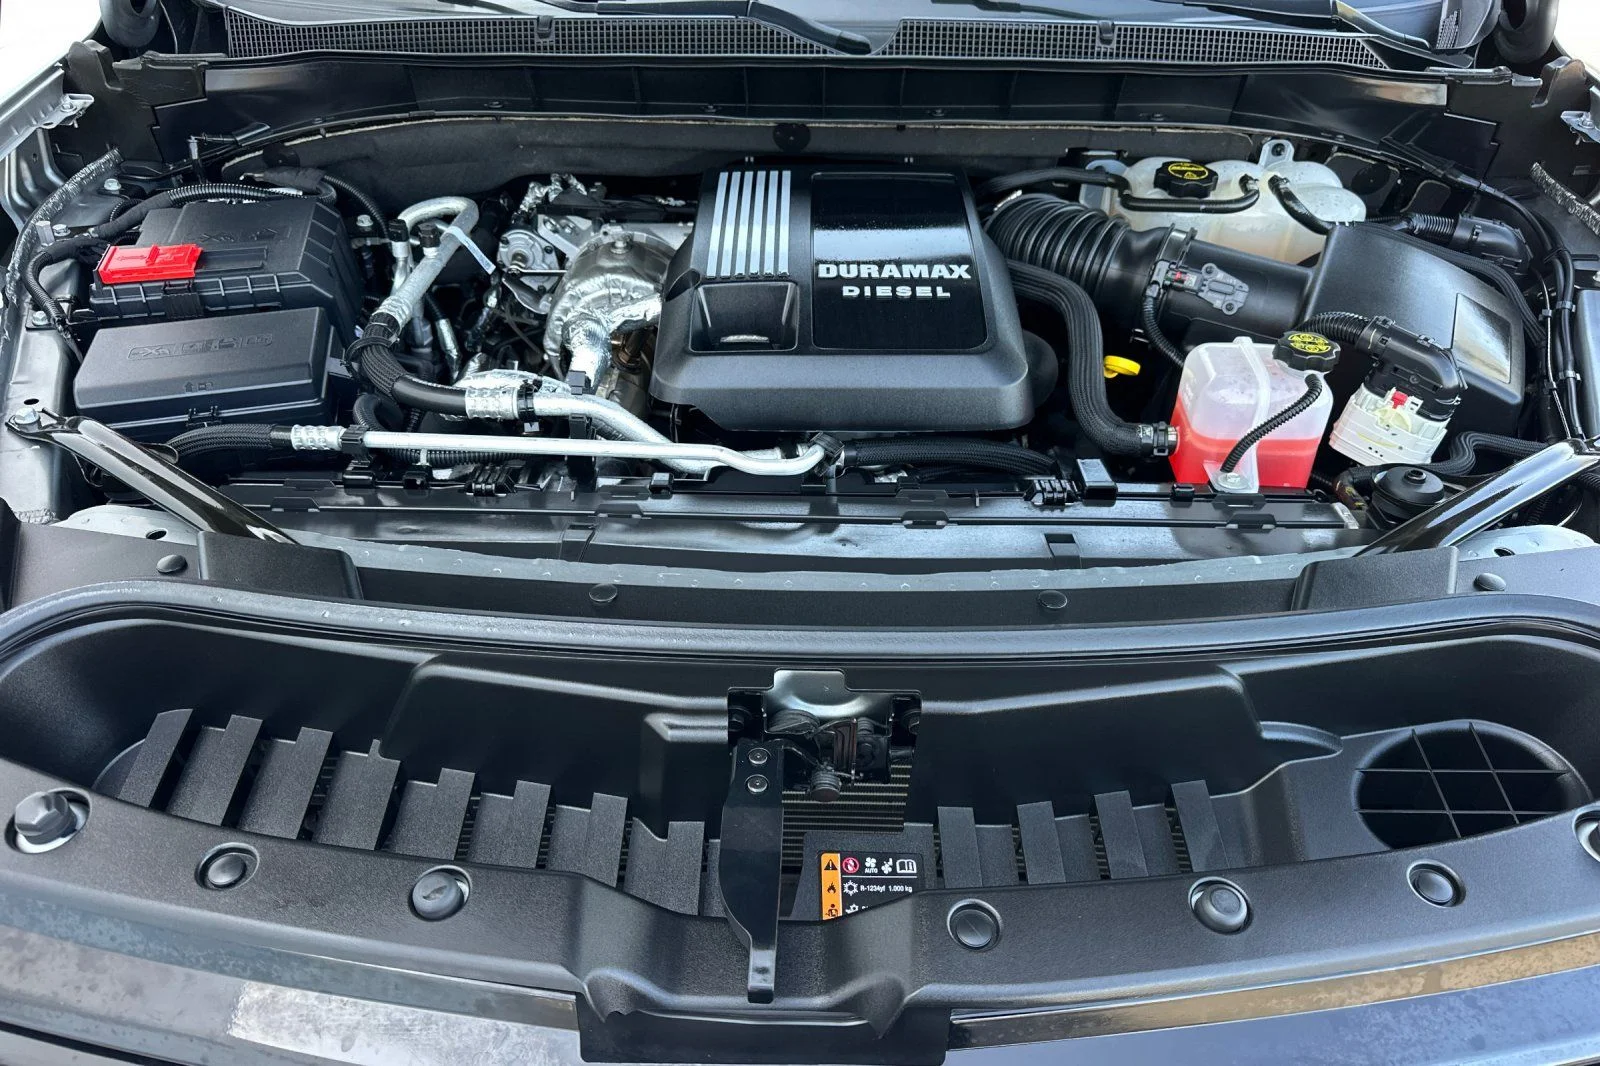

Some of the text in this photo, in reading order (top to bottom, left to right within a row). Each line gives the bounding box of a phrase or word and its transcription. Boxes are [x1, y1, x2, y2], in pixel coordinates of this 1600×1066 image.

[818, 264, 971, 278] DURAMAX
[842, 286, 950, 297] DIESEL
[860, 885, 885, 893] R-1234yf
[905, 885, 912, 893] kg
